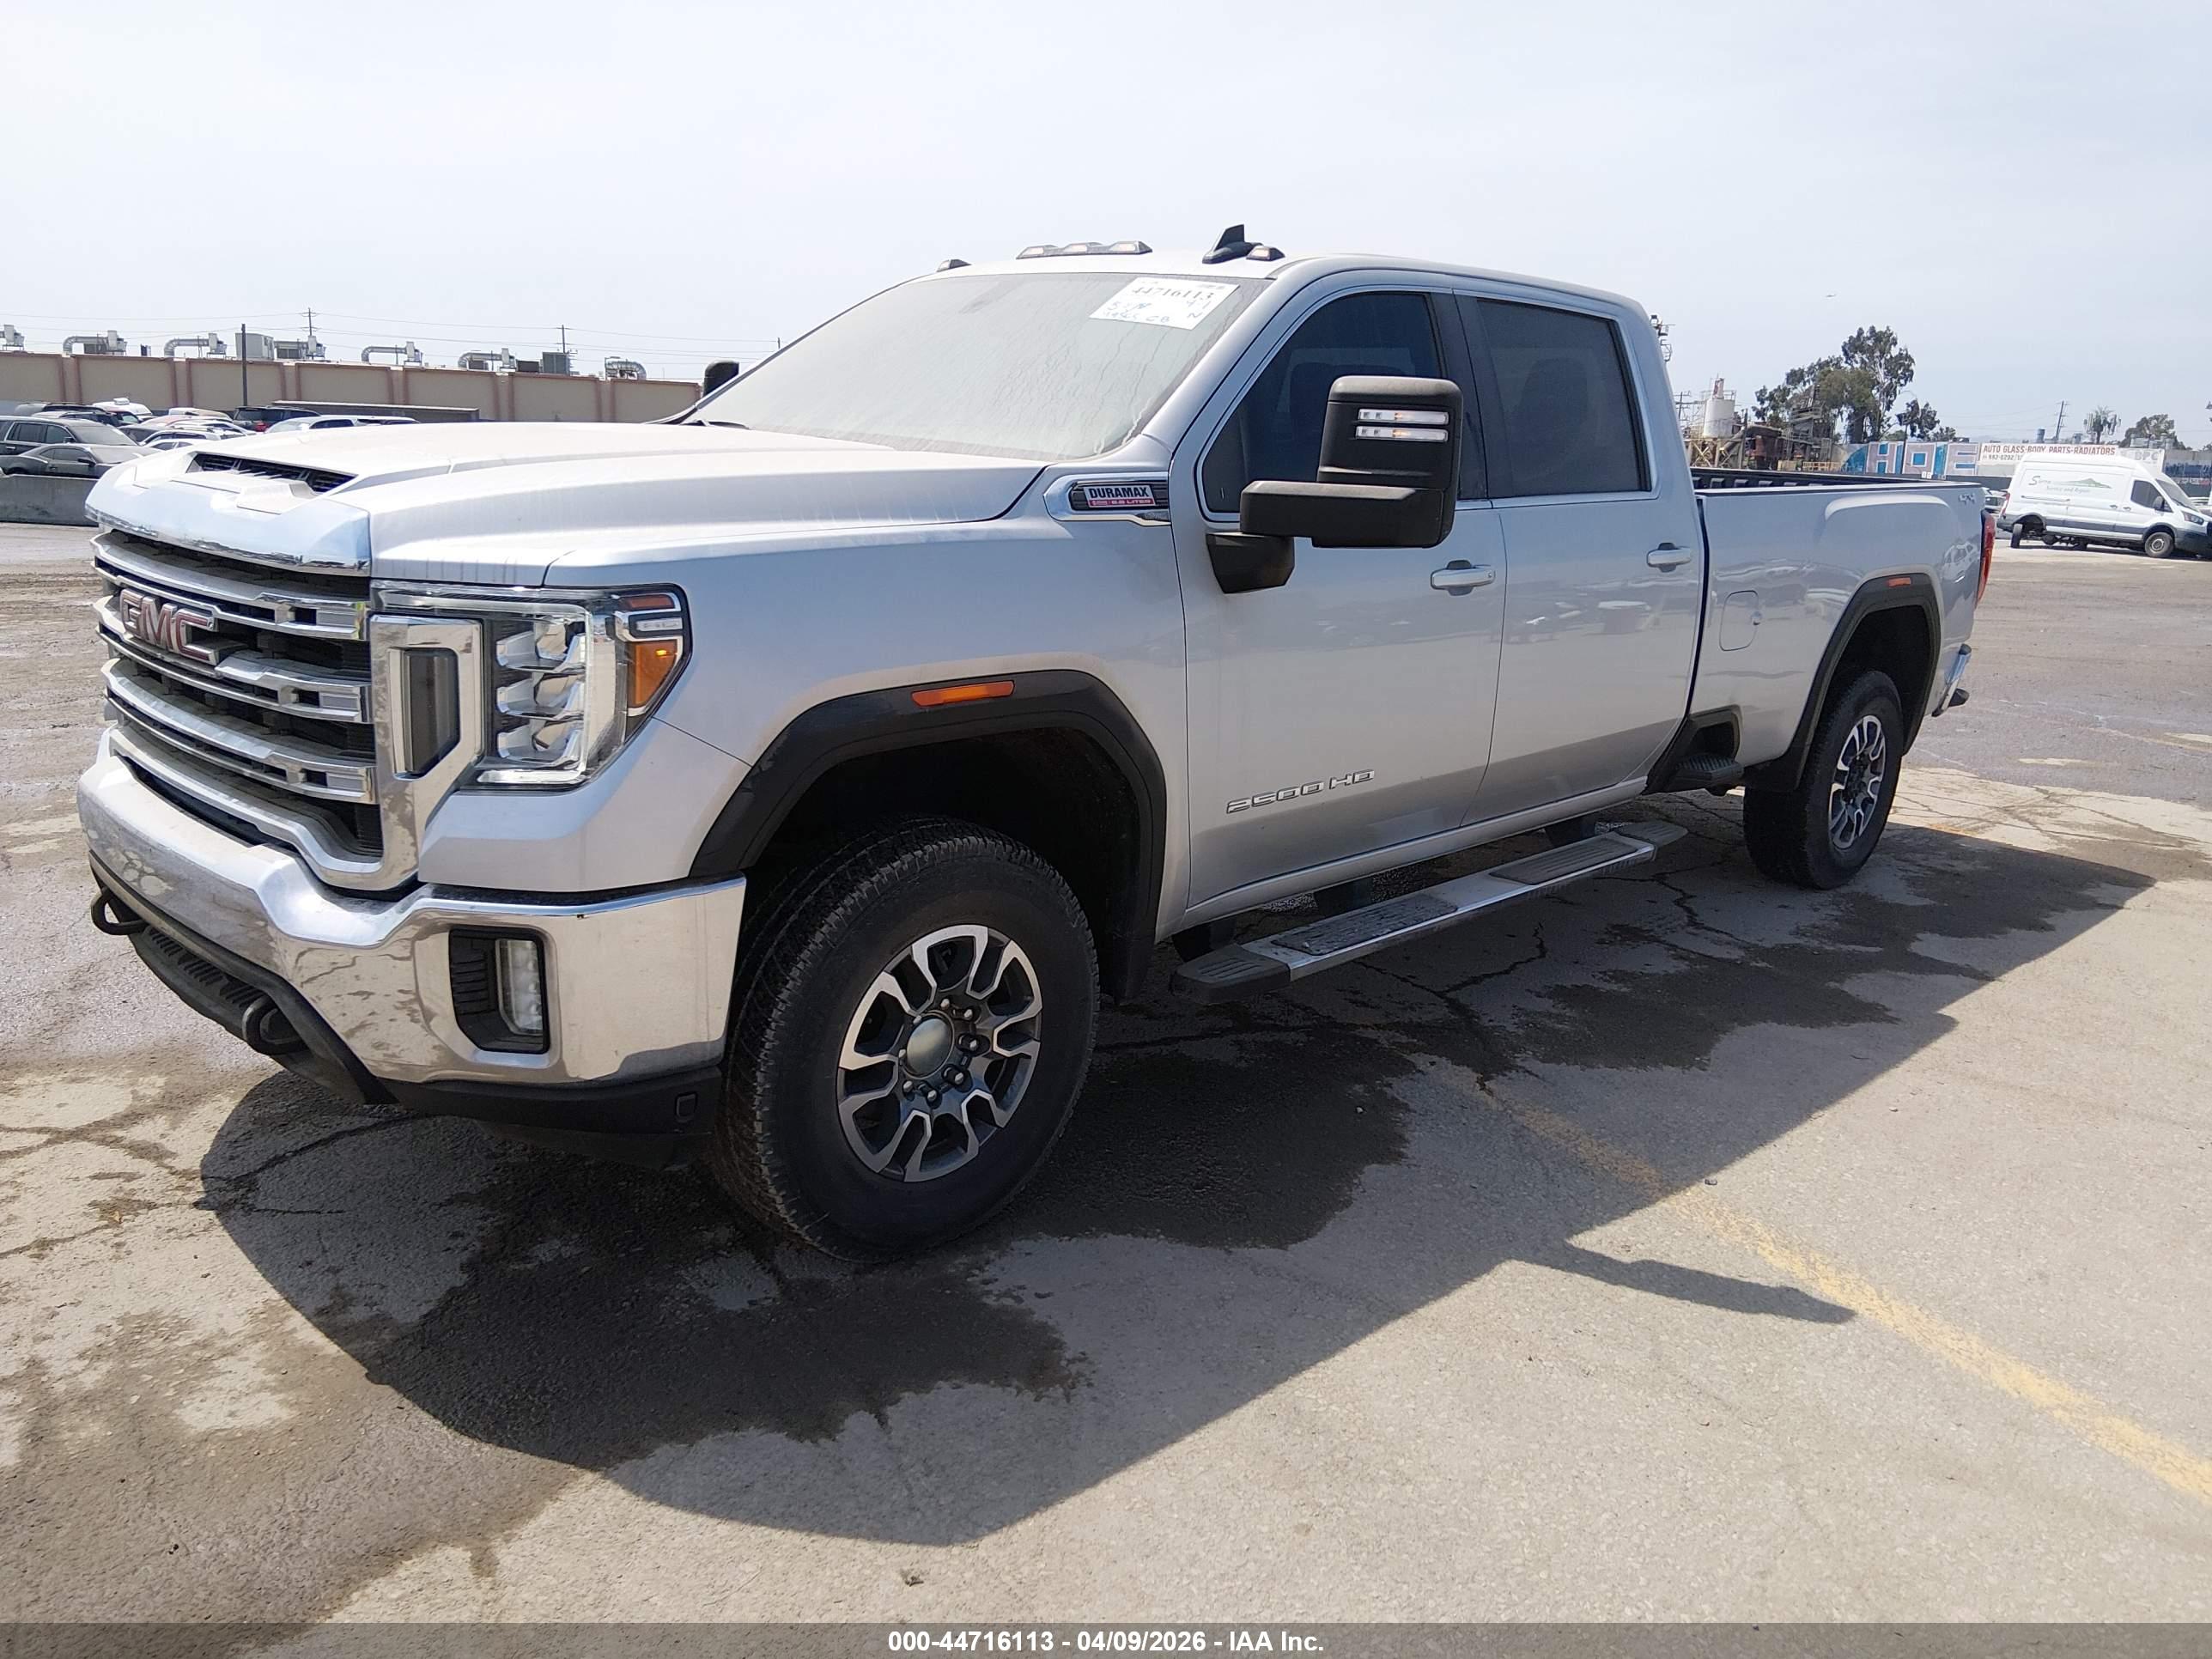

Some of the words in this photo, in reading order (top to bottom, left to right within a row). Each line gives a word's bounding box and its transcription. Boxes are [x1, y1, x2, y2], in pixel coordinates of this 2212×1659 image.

[1132, 287, 1214, 300] 44716113
[1984, 445, 2001, 453] AUTO
[1088, 487, 1150, 499] DURAMAX
[119, 587, 219, 666] GMC
[1225, 780, 1325, 814] 2500
[1328, 769, 1375, 790] HD
